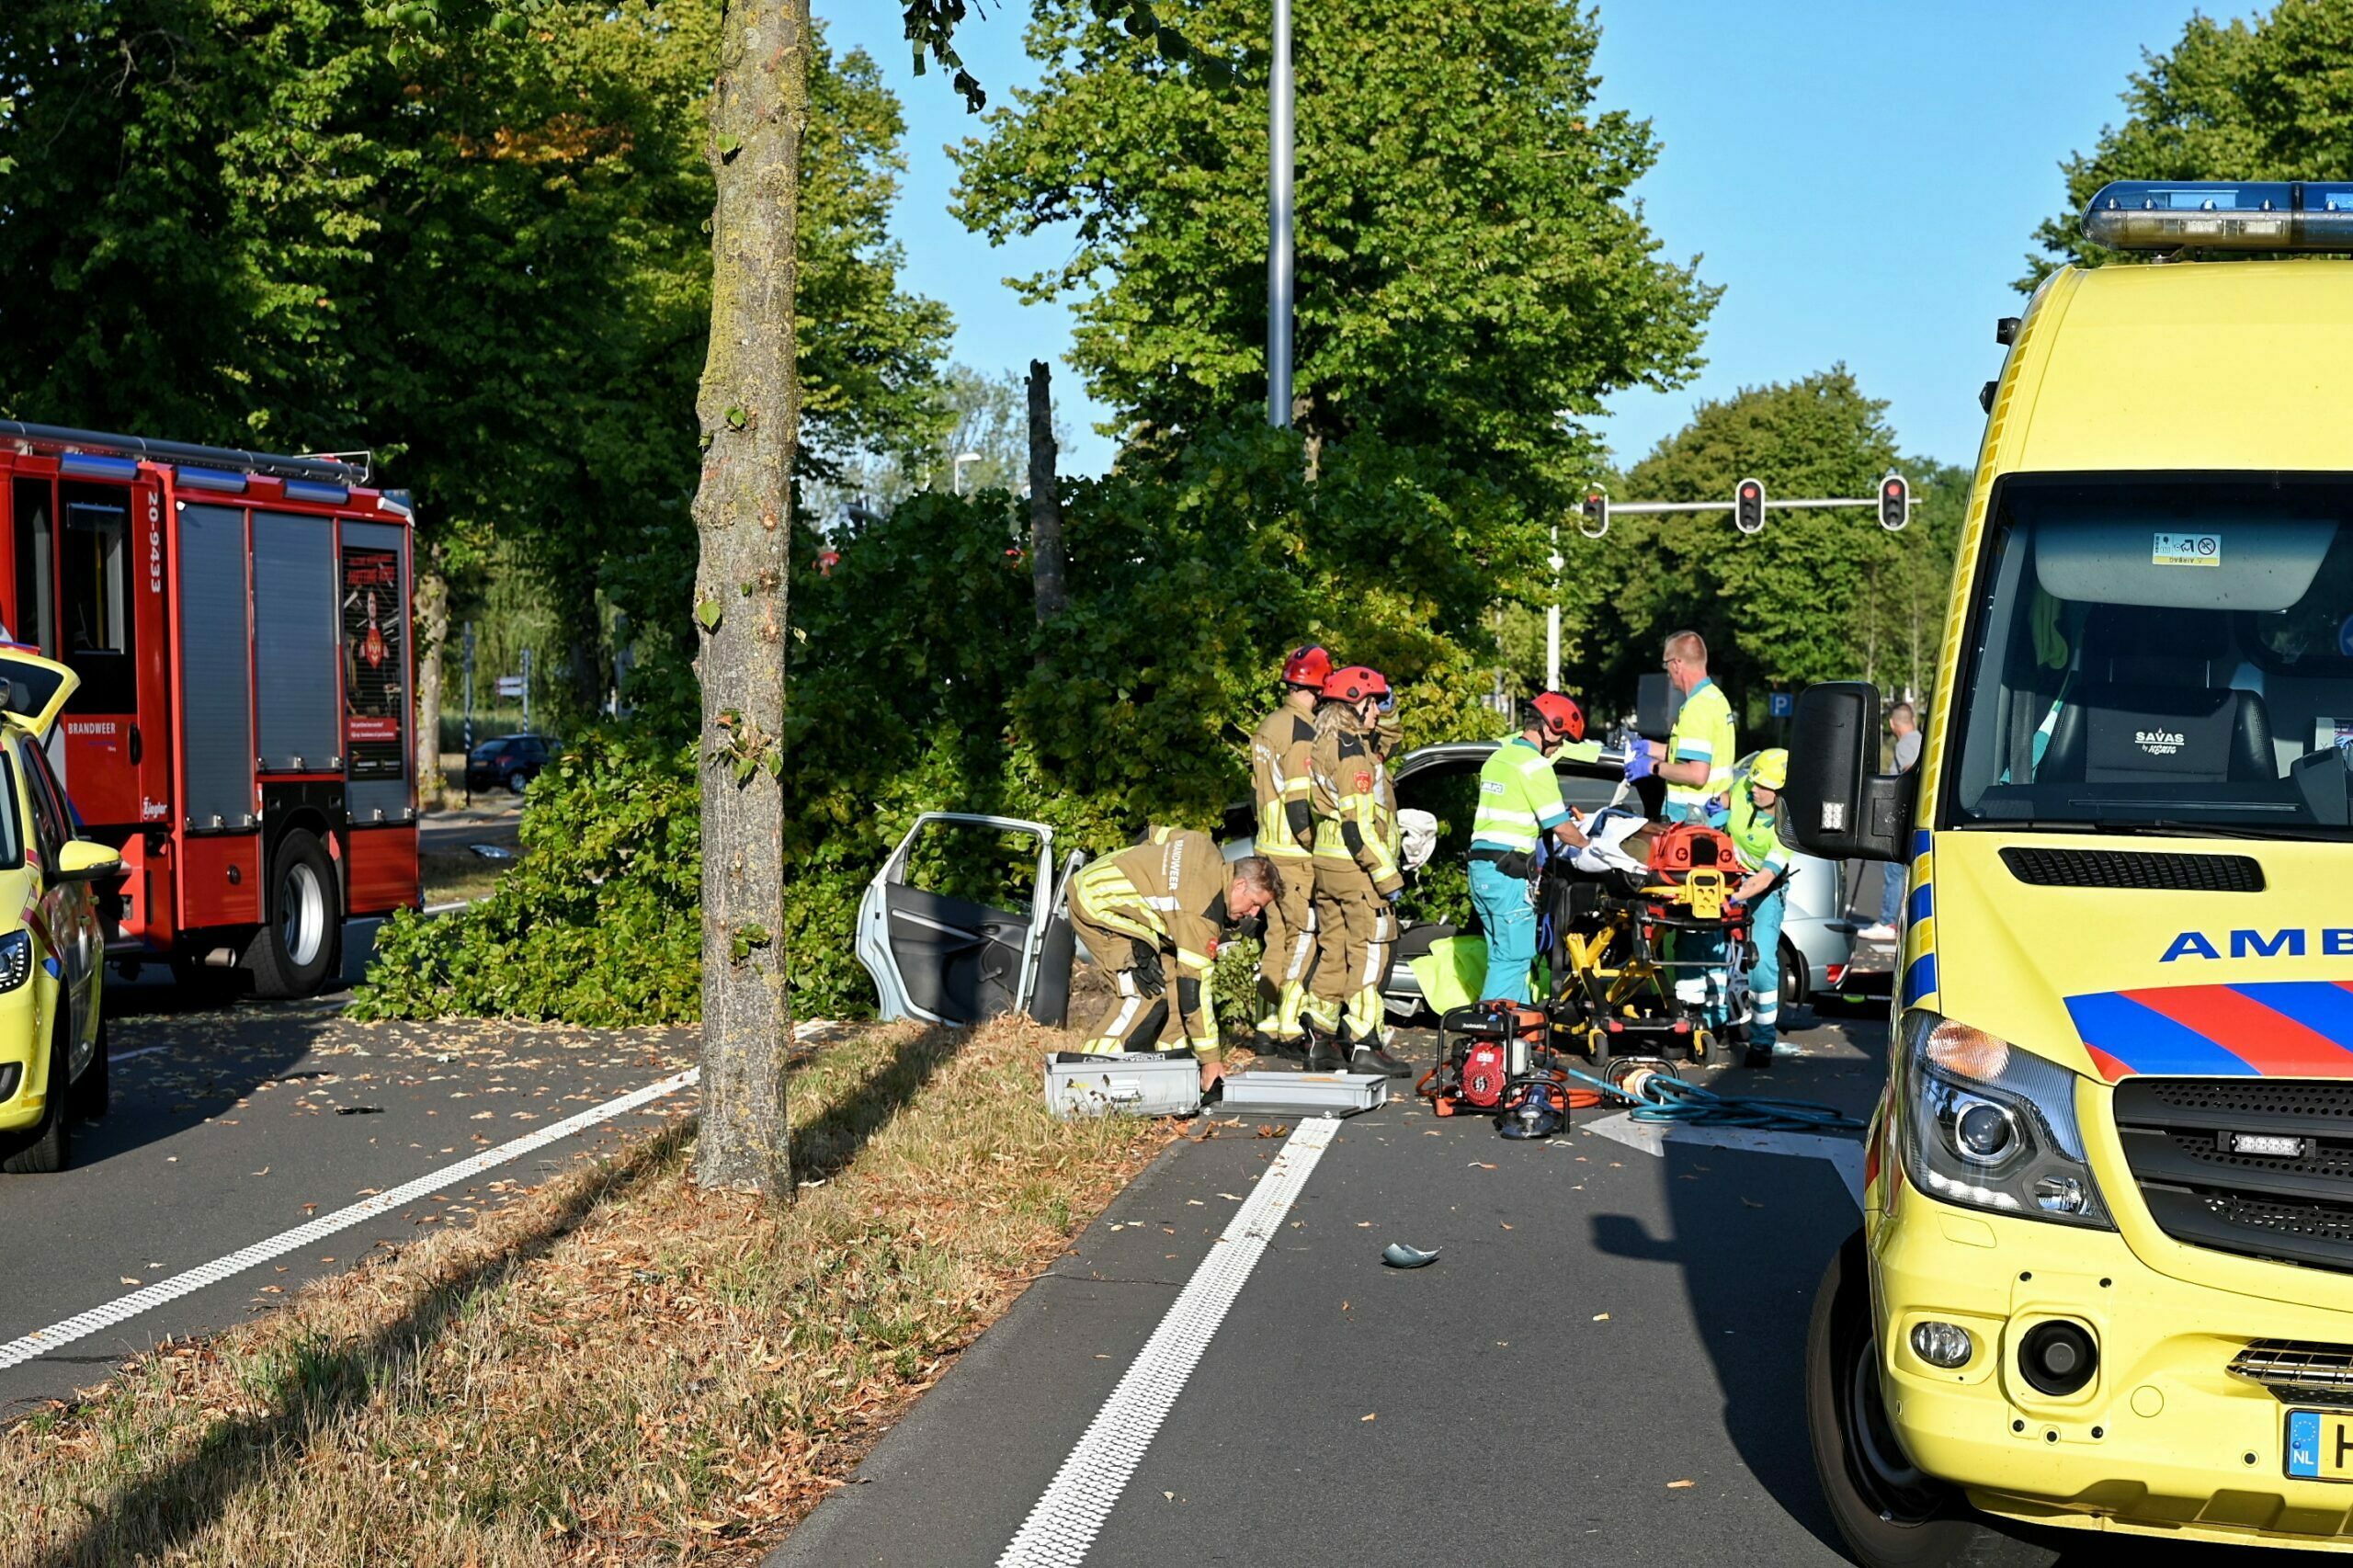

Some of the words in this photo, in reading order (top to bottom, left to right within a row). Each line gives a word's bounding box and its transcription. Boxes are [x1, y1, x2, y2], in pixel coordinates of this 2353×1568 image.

[148, 491, 161, 593] 20-9433
[1775, 697, 1788, 714] P
[68, 722, 116, 734] BRANDWEER
[2135, 731, 2184, 743] SAVAS
[2293, 1449, 2314, 1465] NL
